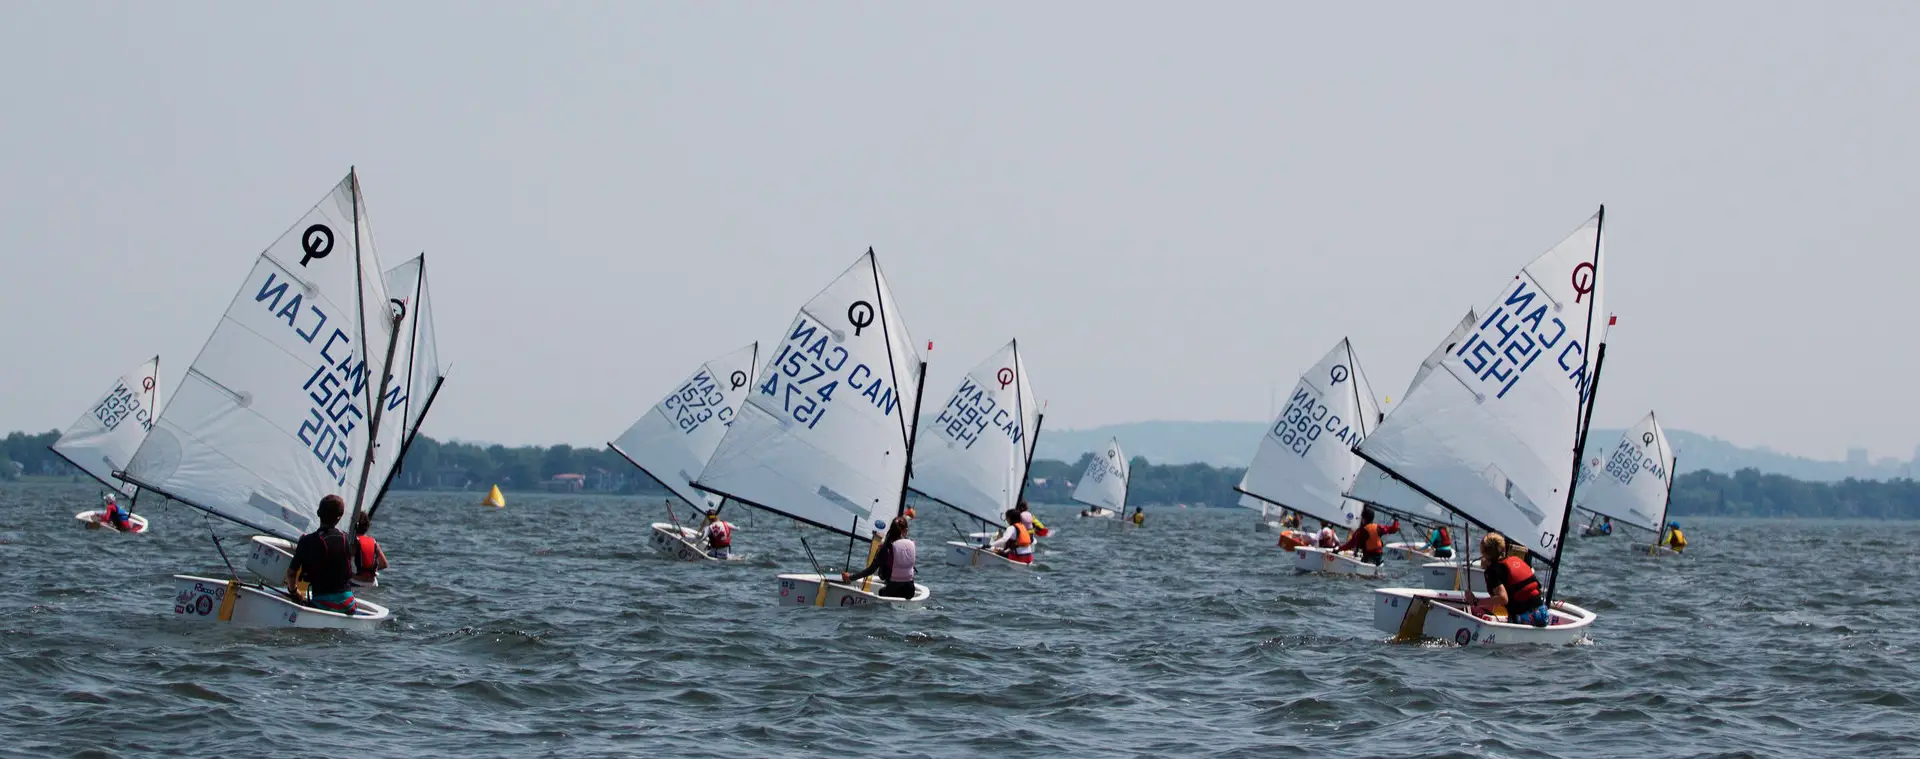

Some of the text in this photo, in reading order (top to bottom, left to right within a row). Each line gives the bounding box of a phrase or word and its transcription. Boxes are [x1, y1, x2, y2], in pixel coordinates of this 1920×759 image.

[774, 344, 839, 403] 1574
[847, 364, 898, 416] CAN
[104, 393, 130, 421] 1321
[679, 382, 713, 423] 1573
[947, 394, 989, 435] 1494
[993, 409, 1024, 444] CAN
[1283, 403, 1322, 441] 1360
[1325, 415, 1362, 448] CAN
[1642, 457, 1665, 480] CAN
